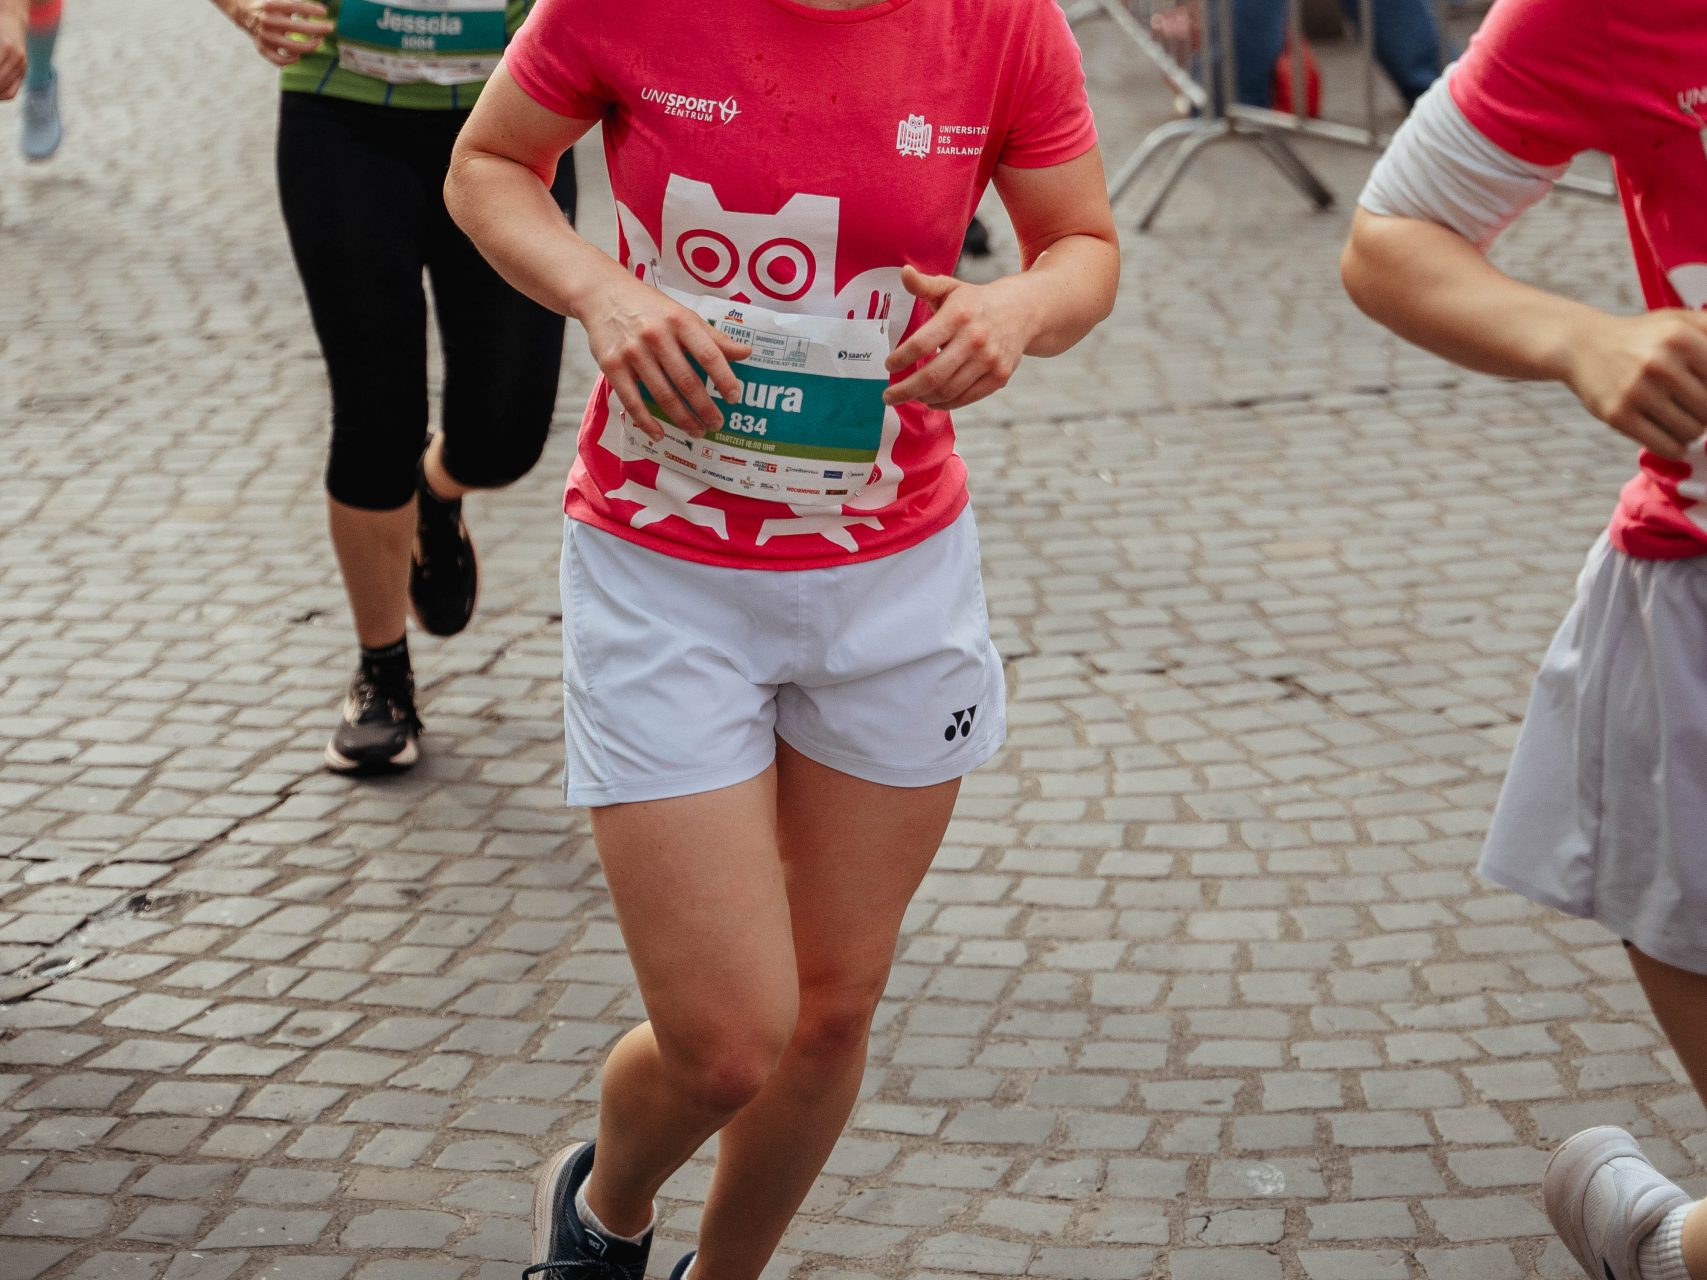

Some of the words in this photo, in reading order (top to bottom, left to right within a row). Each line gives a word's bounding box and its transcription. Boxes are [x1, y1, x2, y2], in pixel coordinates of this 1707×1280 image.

[641, 87, 717, 113] UNISPORT
[664, 106, 713, 122] ZENTRUM
[938, 136, 951, 144] DES
[936, 147, 983, 155] SAARLANDE
[728, 309, 743, 319] dm
[723, 325, 751, 339] FIRMEN
[729, 412, 767, 436] 834
[762, 442, 776, 452] UHR
